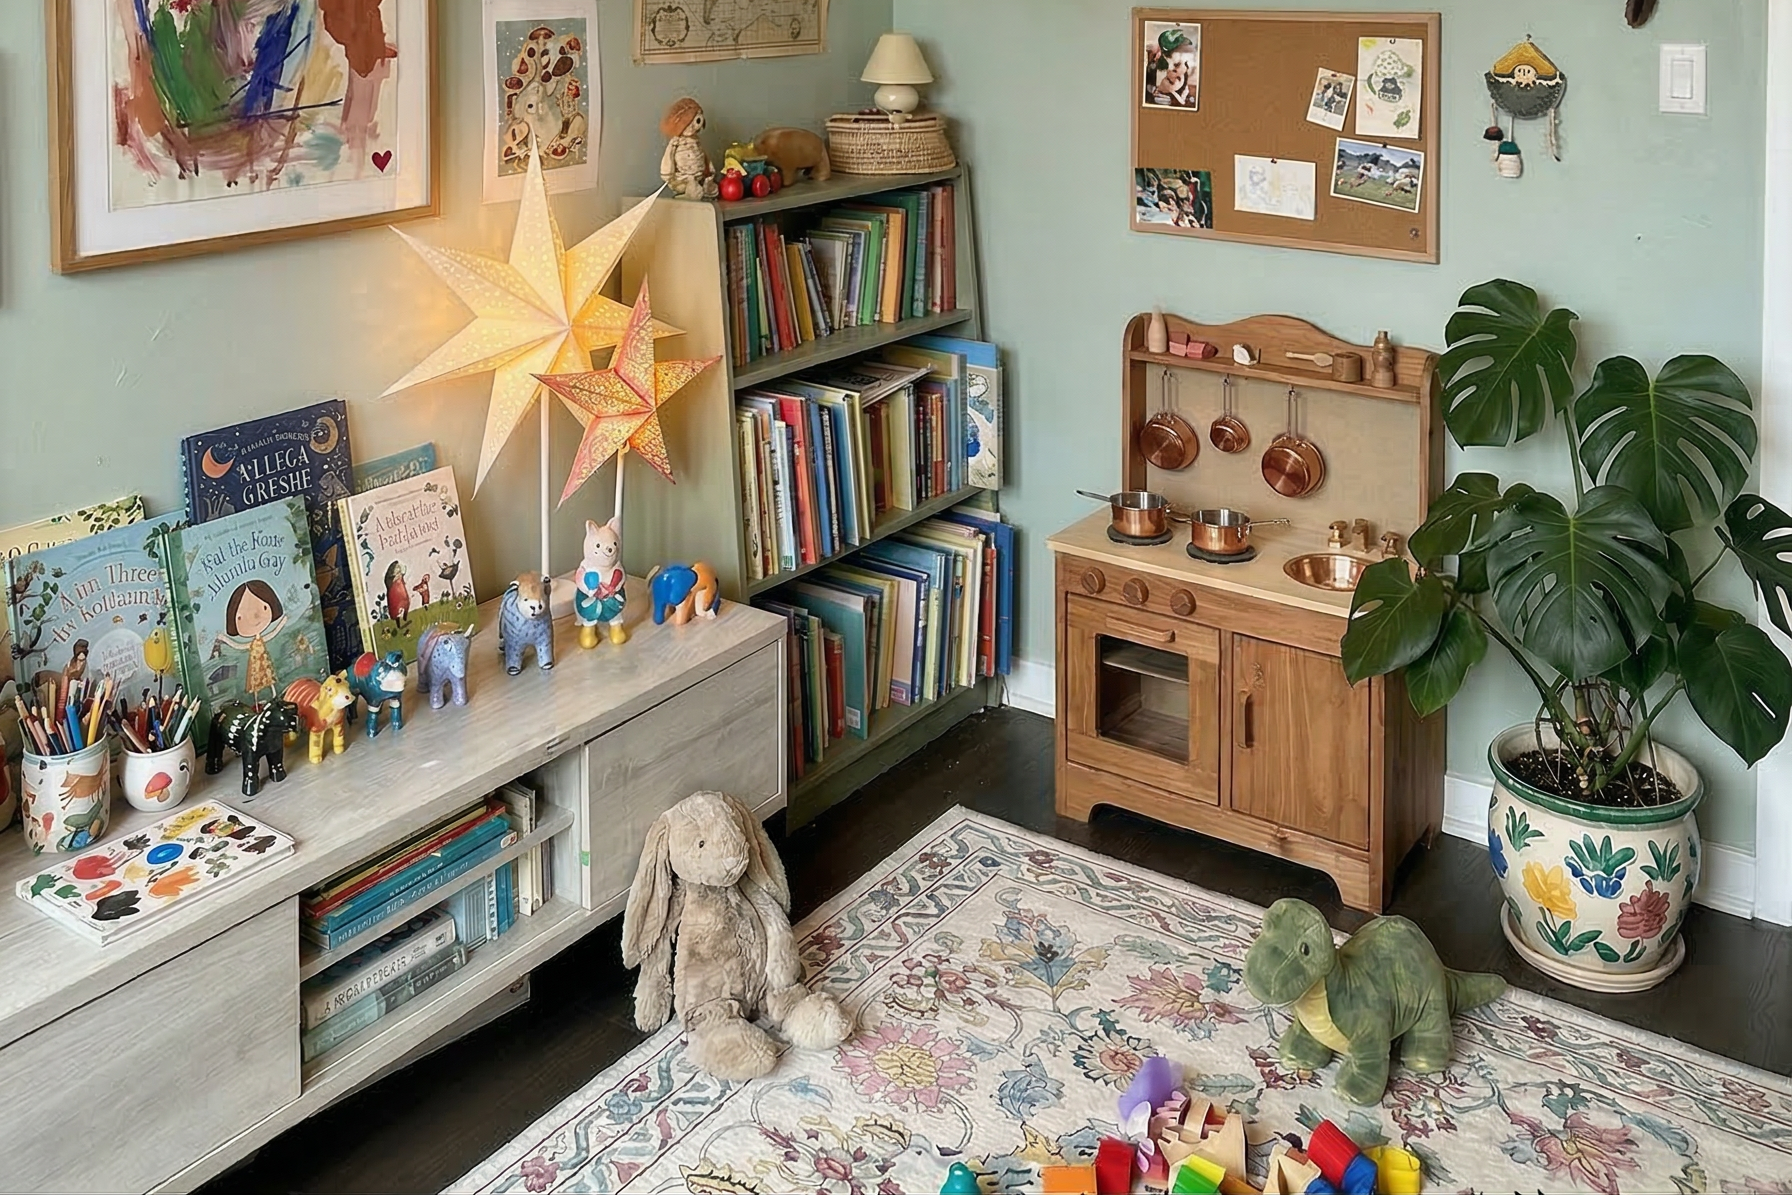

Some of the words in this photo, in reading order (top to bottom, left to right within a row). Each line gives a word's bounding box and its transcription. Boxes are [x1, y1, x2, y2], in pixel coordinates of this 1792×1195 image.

[243, 468, 313, 505] GRESHE
[228, 537, 249, 558] the
[105, 562, 158, 585] Three
[258, 551, 287, 576] Gay
